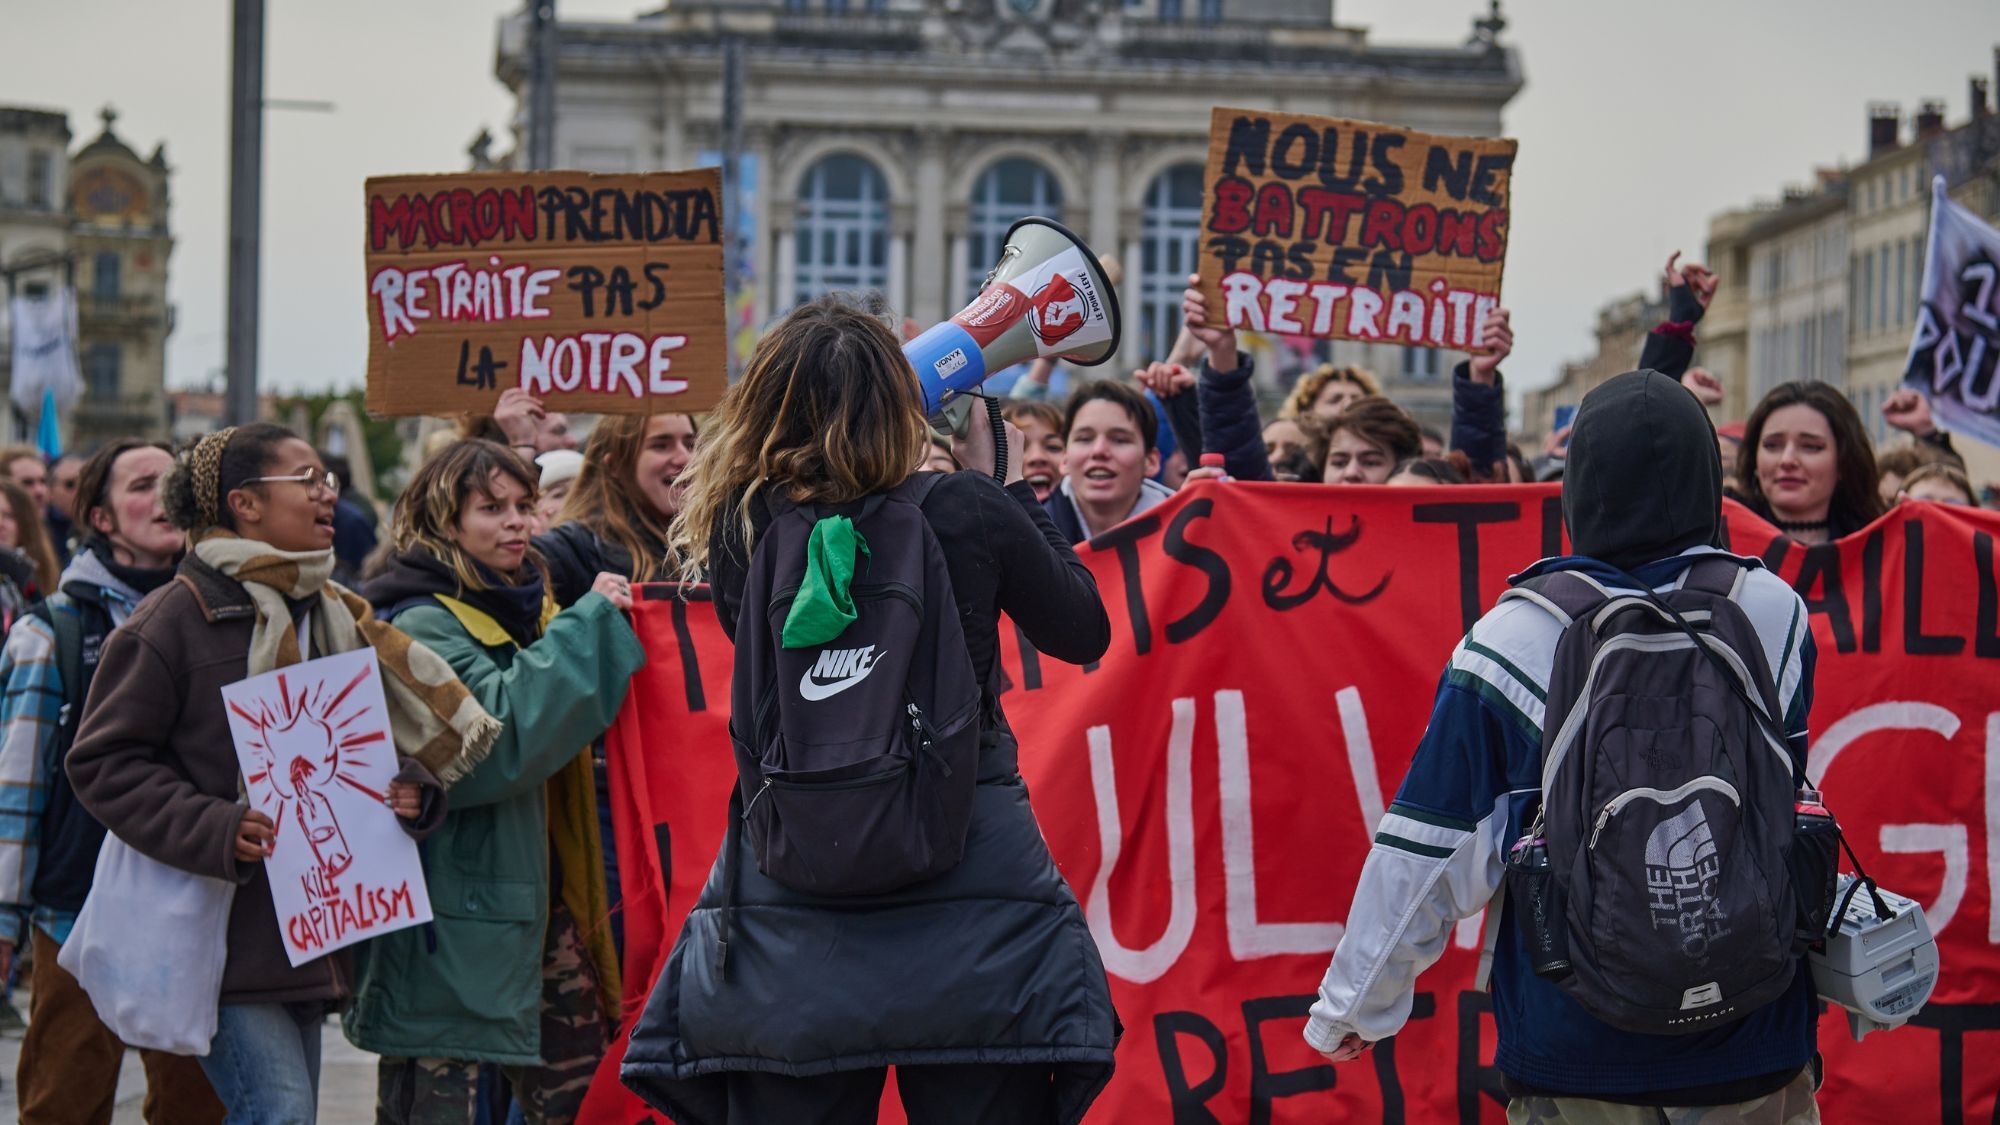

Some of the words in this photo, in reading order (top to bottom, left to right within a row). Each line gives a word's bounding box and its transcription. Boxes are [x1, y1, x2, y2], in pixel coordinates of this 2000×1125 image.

[1222, 115, 1407, 197] NOUS
[1422, 145, 1510, 206] NE
[371, 184, 537, 250] MACRON
[1208, 175, 1508, 263] BATTRONS
[1207, 235, 1317, 279] PAS
[1327, 247, 1413, 292] EN
[371, 256, 561, 342] RETRAITE
[567, 262, 670, 318] PAS
[457, 339, 507, 389] LA
[519, 331, 689, 399] NOTRE
[935, 349, 961, 368] VONYX
[1263, 514, 1394, 611] et
[812, 644, 876, 678] NIKE
[1645, 866, 1678, 931] THE
[1668, 1006, 1735, 1025] HAYSTACK
